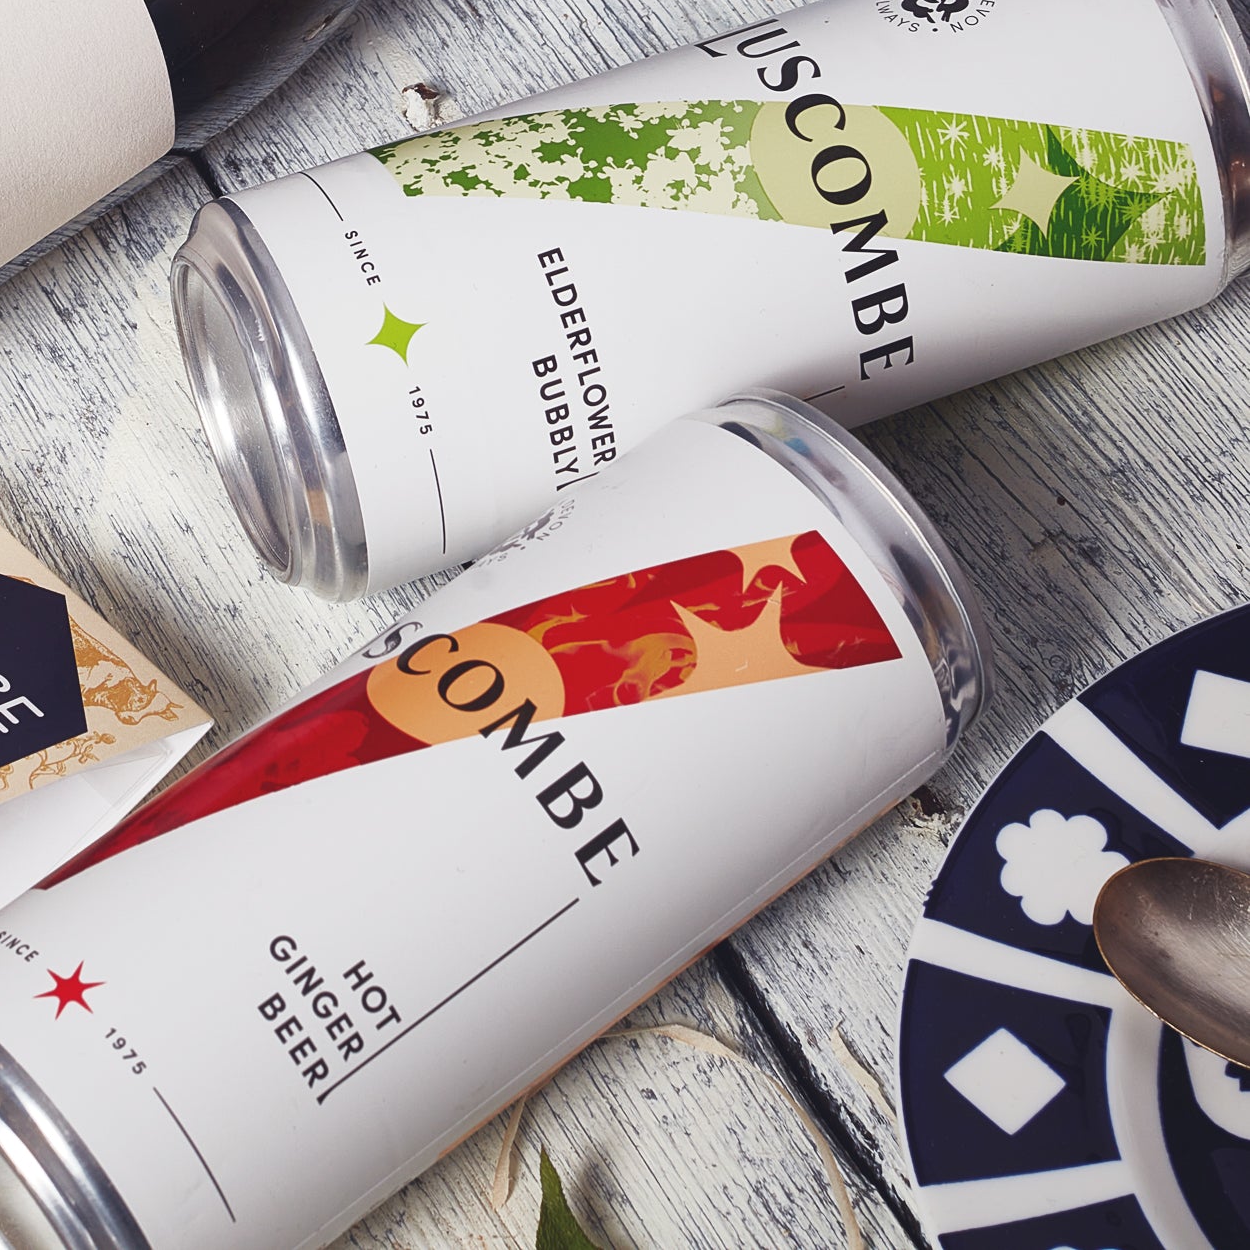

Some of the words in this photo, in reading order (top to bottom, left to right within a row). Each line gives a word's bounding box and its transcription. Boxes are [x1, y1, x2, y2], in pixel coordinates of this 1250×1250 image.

[695, 18, 915, 382] LUSCOMBE
[343, 229, 382, 288] SINCE
[406, 384, 434, 438] 1975
[536, 246, 617, 467] ELDERFLOWER
[532, 355, 580, 475] BUBBLY
[362, 621, 642, 888] SCOMBE
[103, 1026, 147, 1077] 1975
[257, 992, 330, 1089] BEER
[269, 935, 365, 1062] GINGER
[342, 959, 402, 1031] HOT
